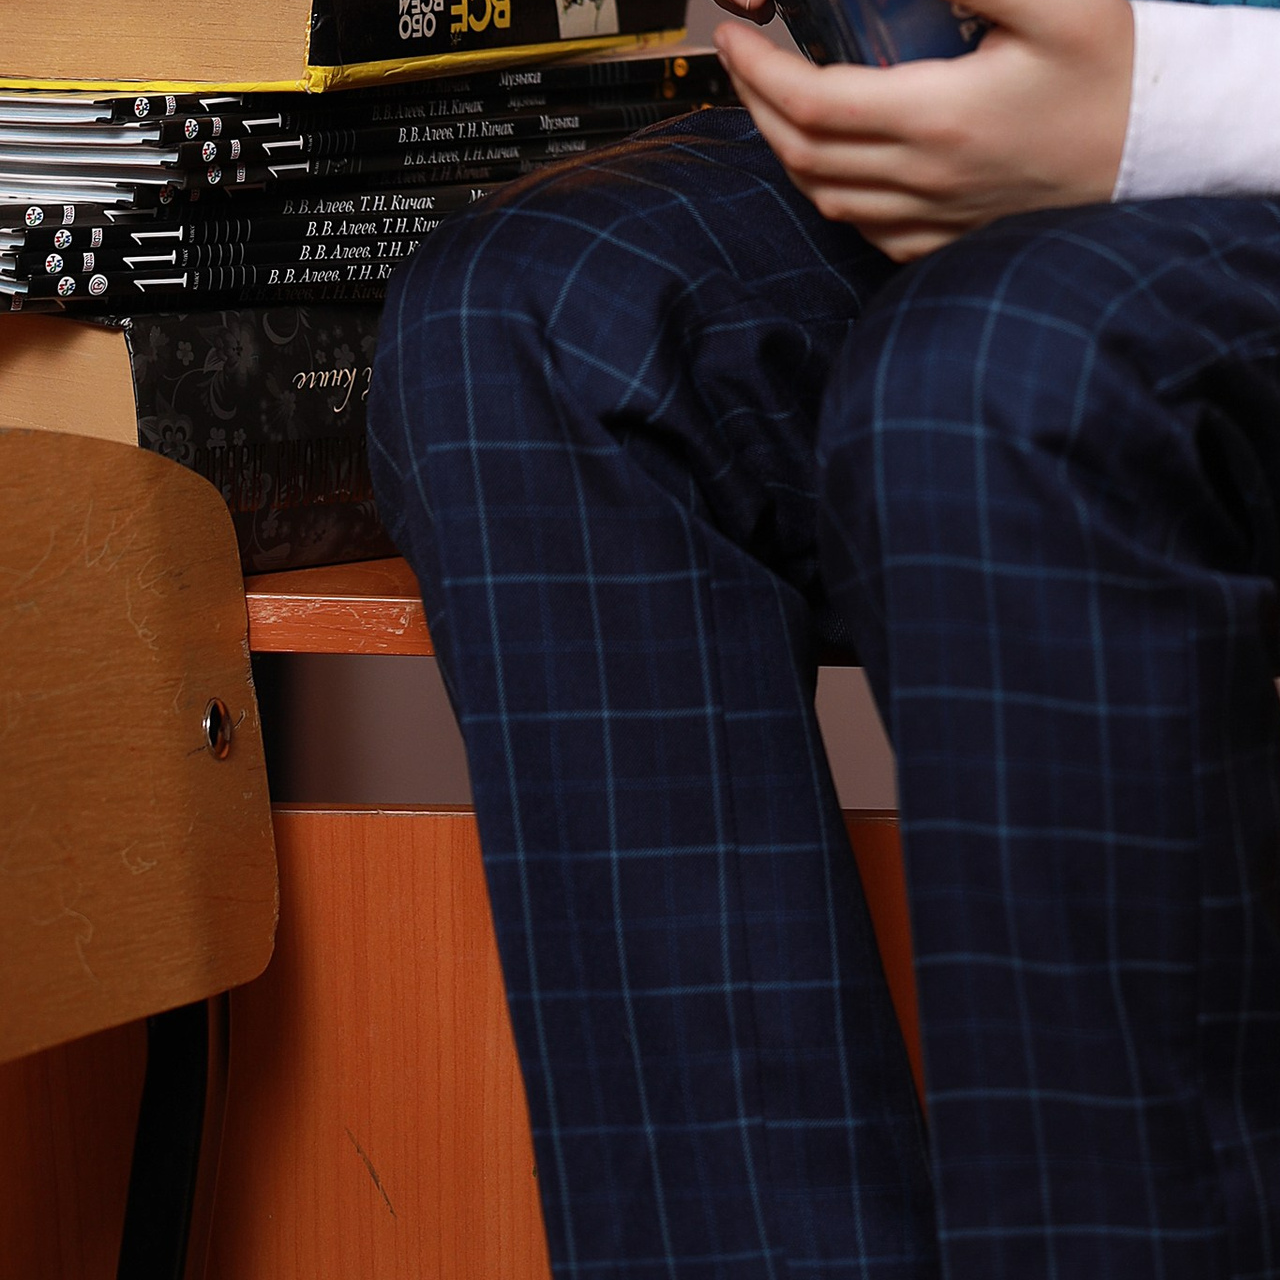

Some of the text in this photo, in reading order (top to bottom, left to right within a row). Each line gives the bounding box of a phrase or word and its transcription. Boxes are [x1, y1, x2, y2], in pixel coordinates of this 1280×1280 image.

[399, 12, 437, 39] ОБО
[481, 120, 515, 137] Кичак
[539, 114, 580, 135] Музыка
[390, 193, 436, 211] Кичак
[412, 216, 445, 233] Кич
[292, 368, 358, 413] книге
